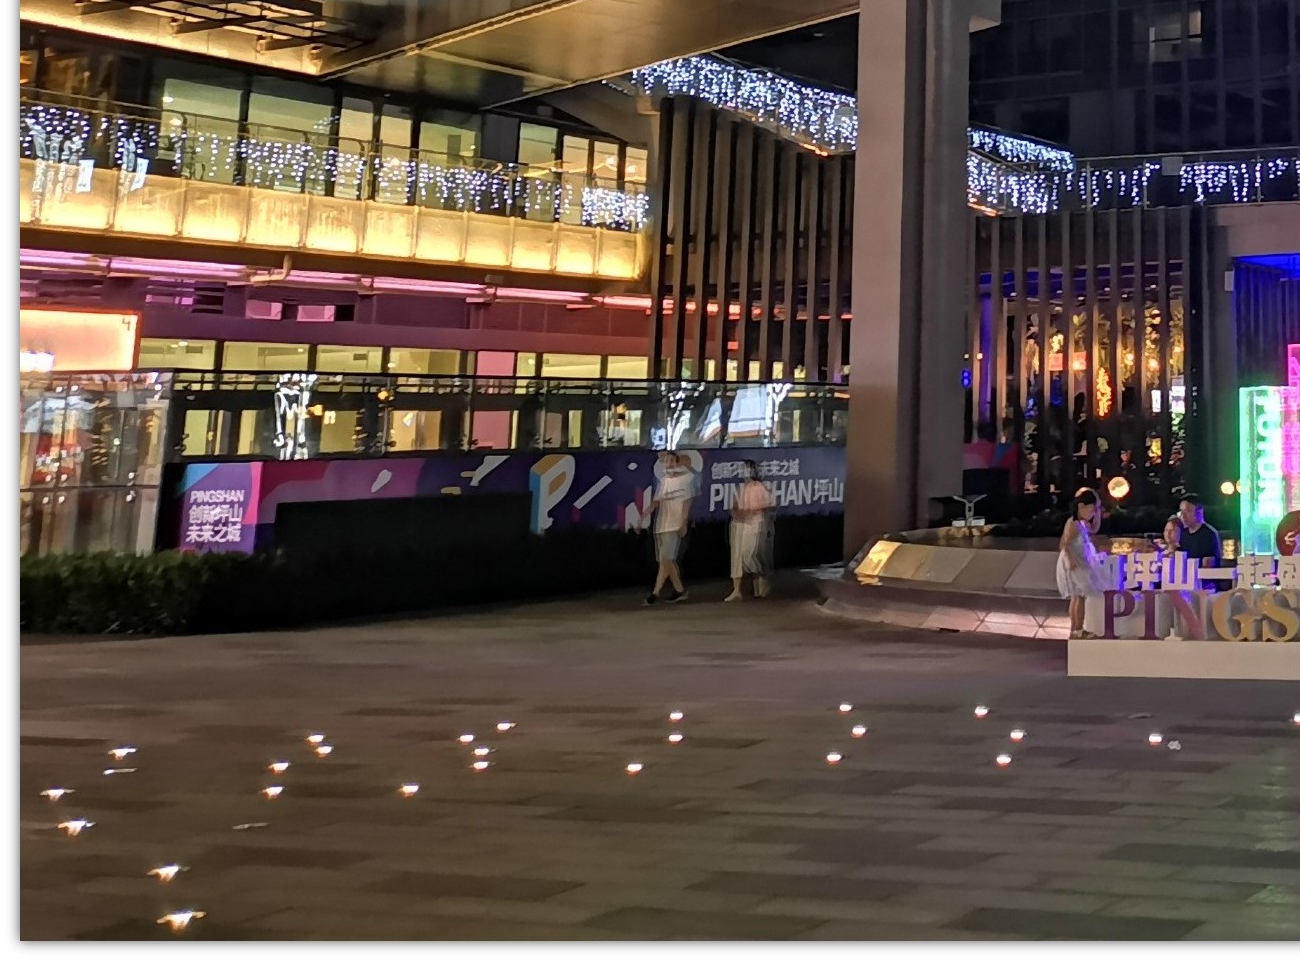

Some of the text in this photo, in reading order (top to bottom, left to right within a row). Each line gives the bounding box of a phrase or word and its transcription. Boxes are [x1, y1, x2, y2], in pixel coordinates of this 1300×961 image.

[189, 489, 246, 503] PINGSHAN
[709, 478, 812, 512] PINHAN
[188, 504, 243, 523] 创新坪山
[185, 523, 242, 542] 未来之城
